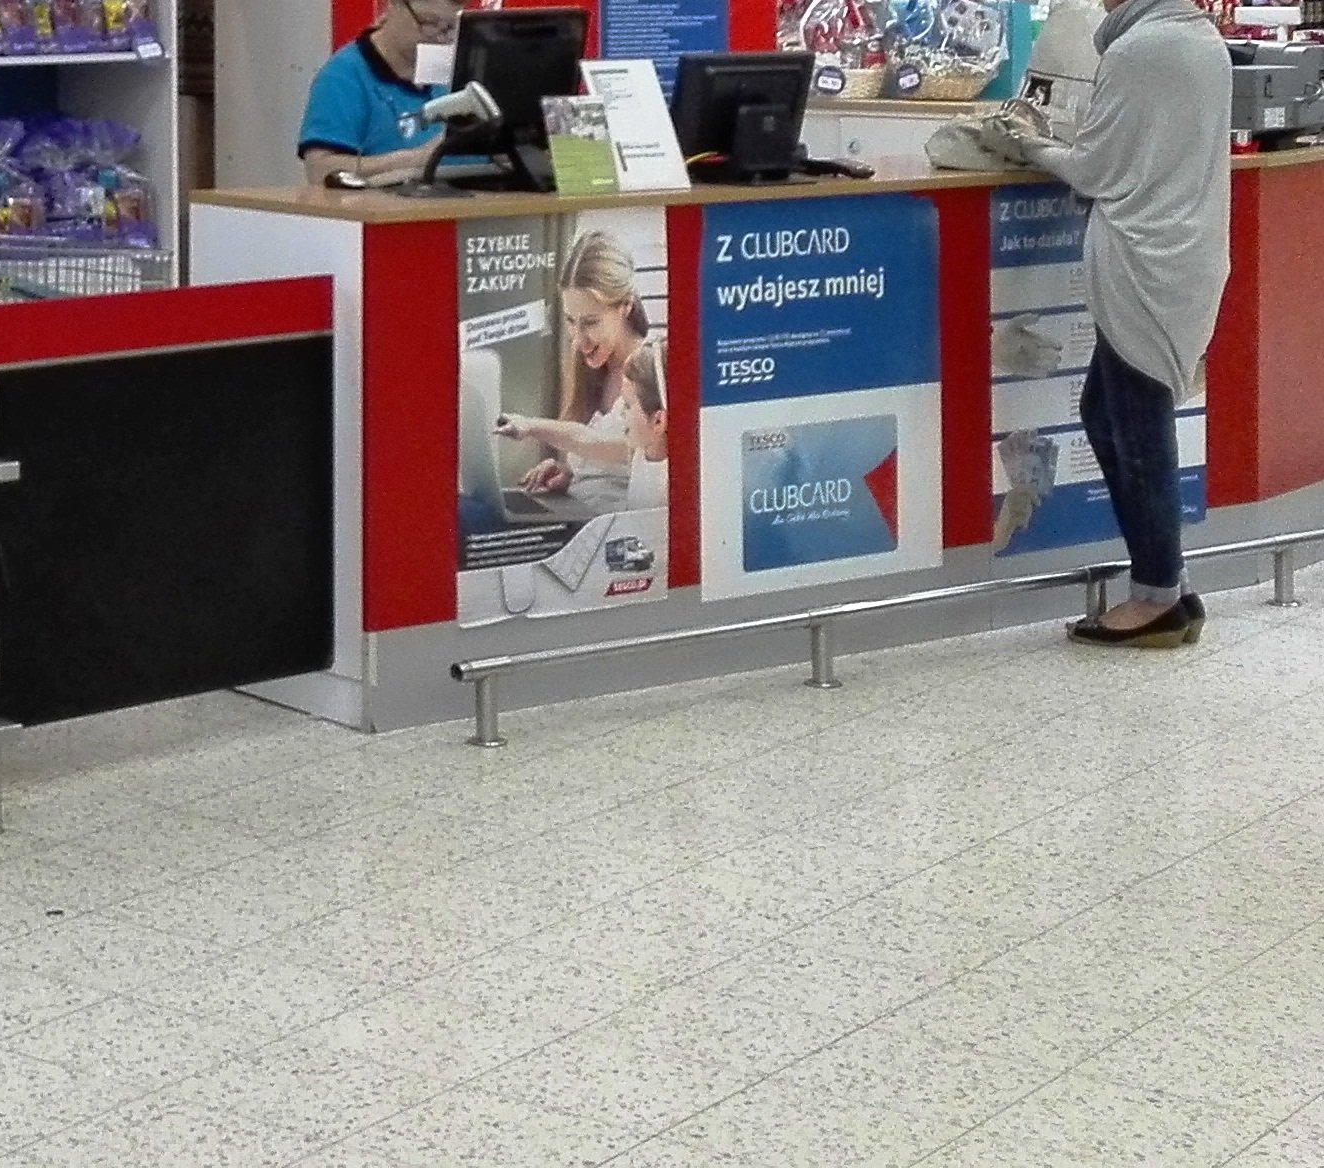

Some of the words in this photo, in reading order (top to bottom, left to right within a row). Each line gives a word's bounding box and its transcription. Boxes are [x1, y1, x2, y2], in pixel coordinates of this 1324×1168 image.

[466, 234, 530, 253] SZYBKIE
[716, 234, 734, 263] Z
[740, 227, 851, 261] CLUBCARD
[478, 252, 556, 271] WYGODNE
[466, 274, 526, 293] ZAKUPY
[716, 274, 822, 311] wydajesz
[824, 266, 886, 300] mniej
[717, 357, 775, 378] TESCO
[749, 477, 853, 514] CLUBCARD
